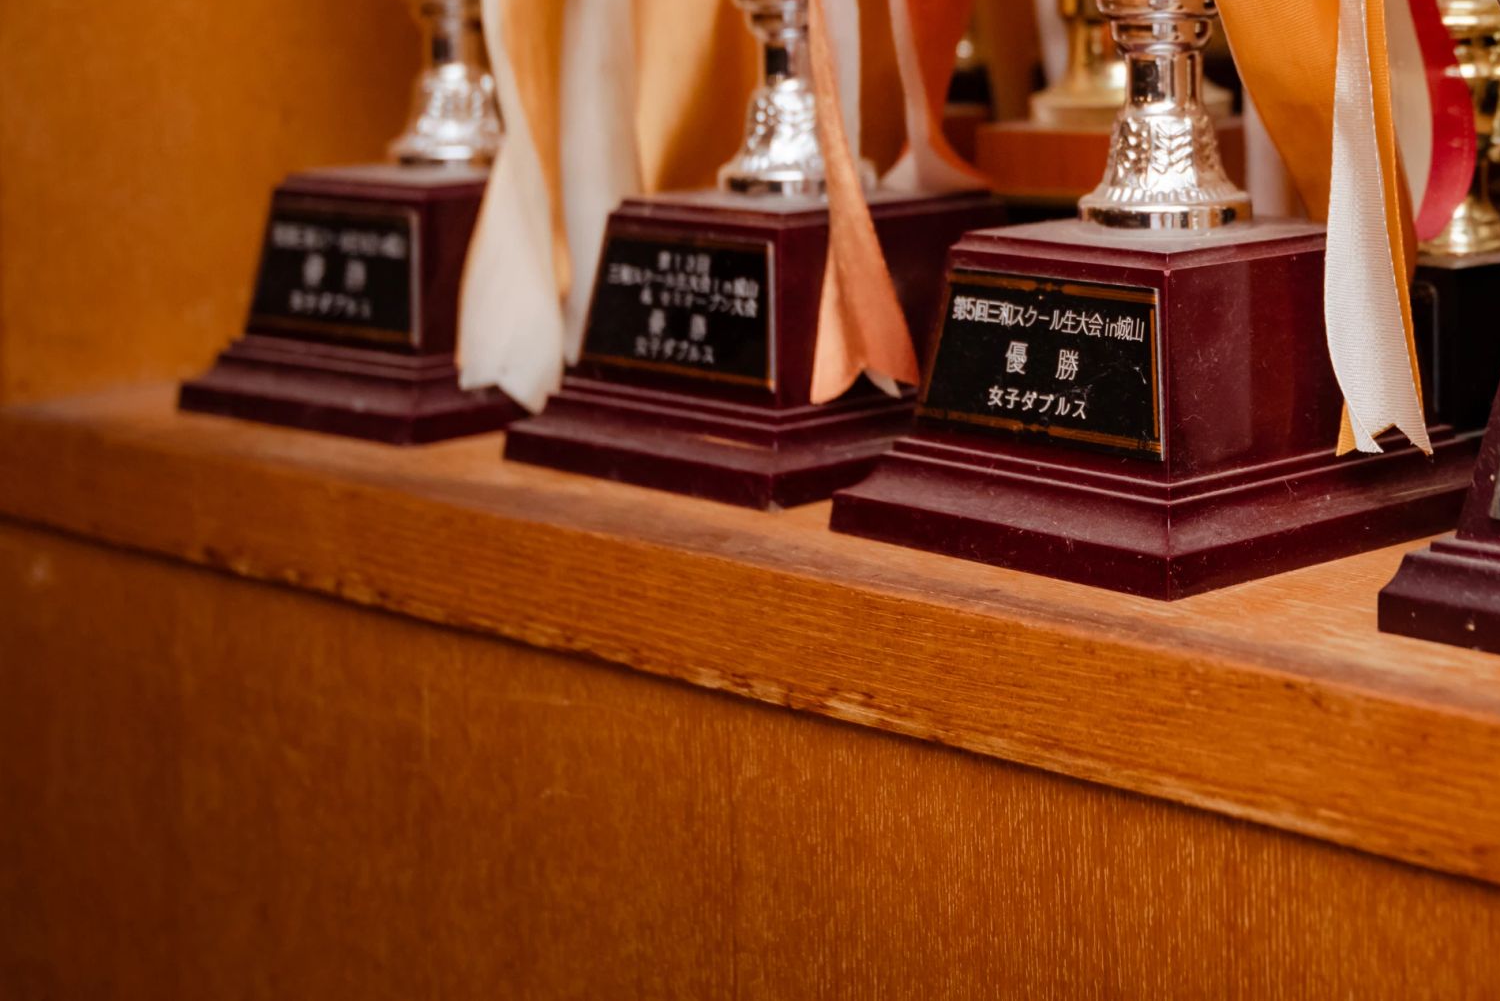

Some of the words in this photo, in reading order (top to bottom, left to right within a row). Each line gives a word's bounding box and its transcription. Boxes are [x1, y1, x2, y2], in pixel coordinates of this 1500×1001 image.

[986, 384, 1088, 420] 女子ダブルス
